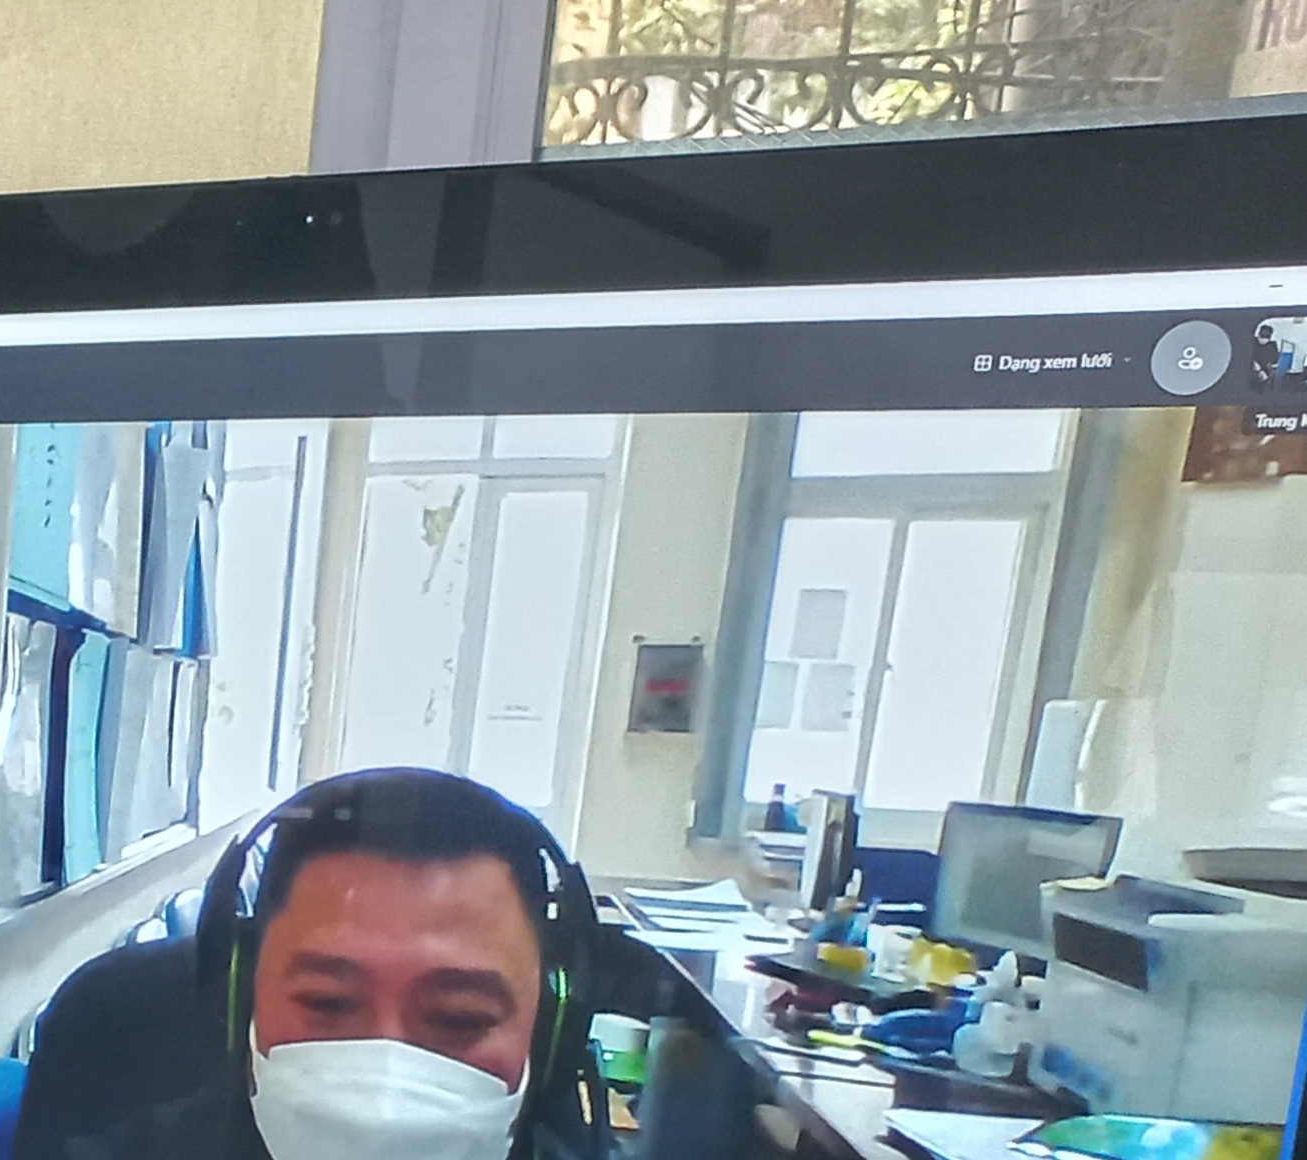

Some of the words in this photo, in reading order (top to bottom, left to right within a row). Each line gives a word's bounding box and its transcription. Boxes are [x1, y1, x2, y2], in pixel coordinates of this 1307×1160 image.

[998, 355, 1041, 374] Dạng
[1043, 355, 1078, 370] xem
[1080, 352, 1113, 369] lưới
[1256, 413, 1299, 431] Trung
